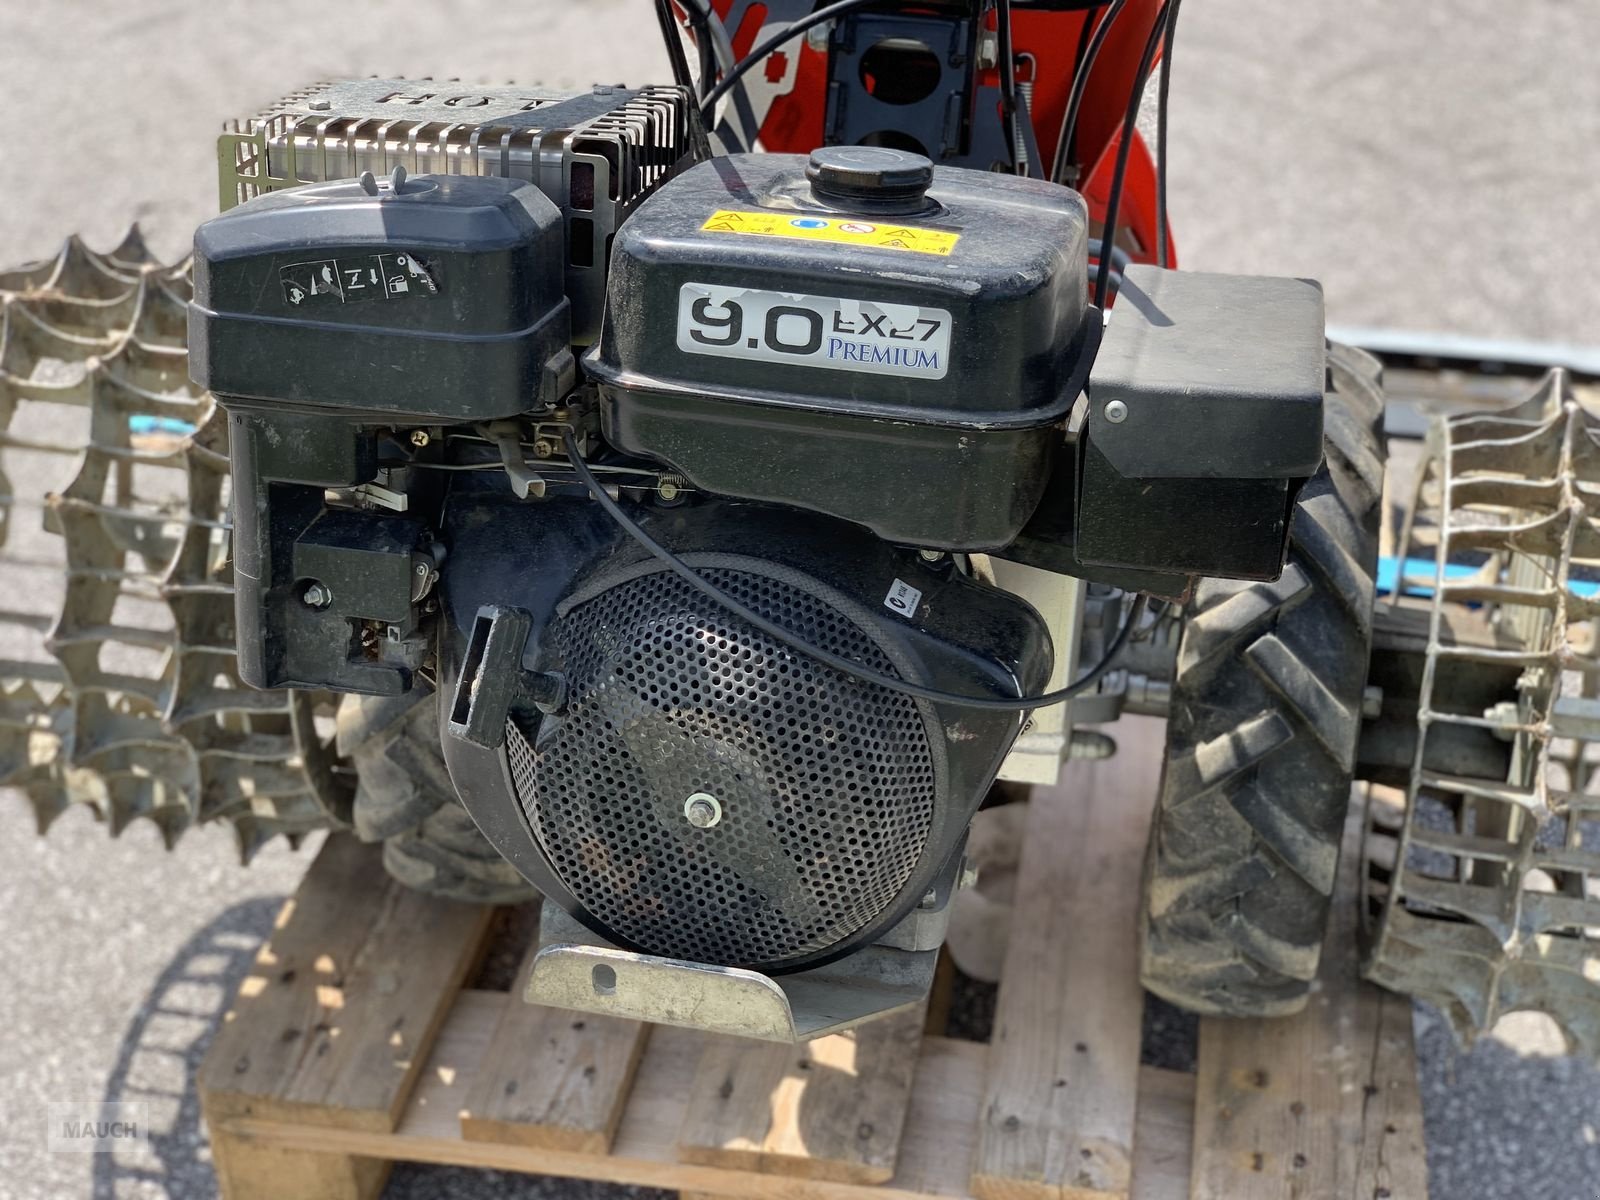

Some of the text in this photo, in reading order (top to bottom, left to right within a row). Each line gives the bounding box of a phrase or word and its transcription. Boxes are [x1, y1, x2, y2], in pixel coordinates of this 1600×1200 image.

[375, 92, 563, 111] HOT
[690, 297, 824, 355] 9.0
[828, 337, 940, 370] PREMIUM
